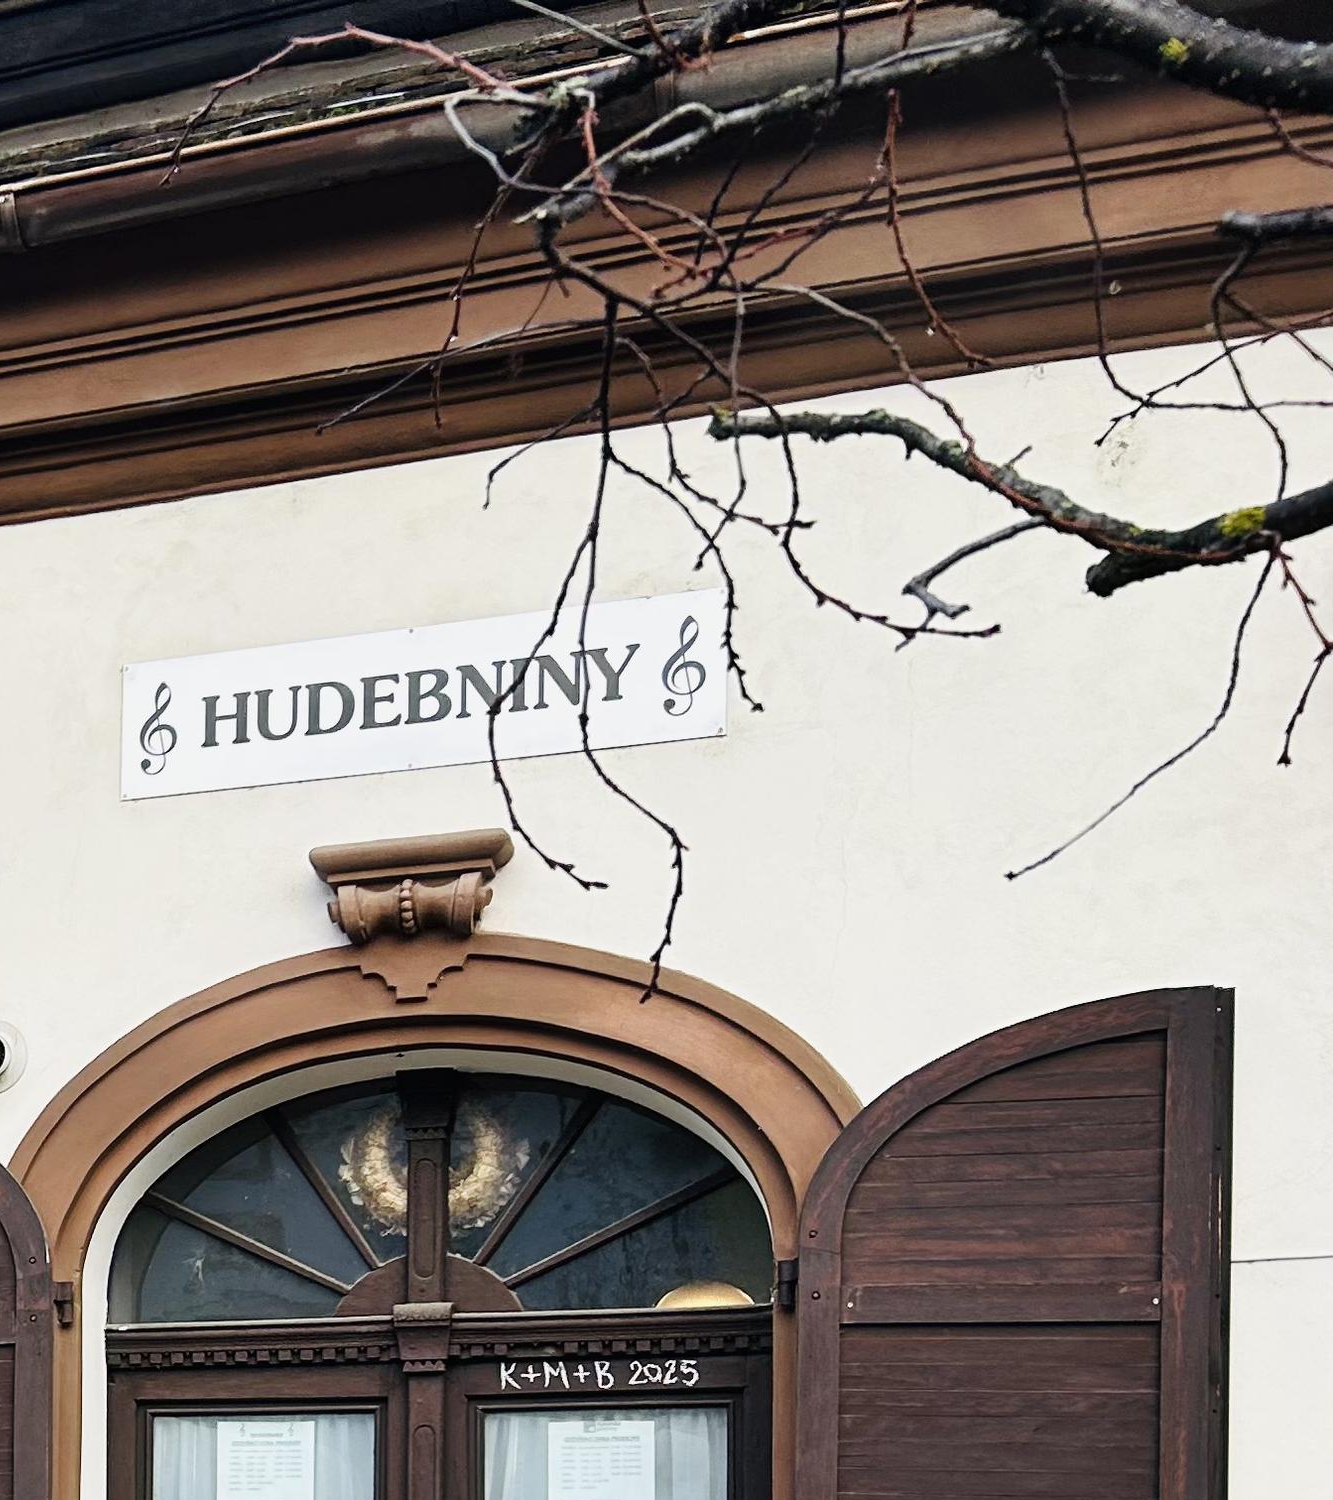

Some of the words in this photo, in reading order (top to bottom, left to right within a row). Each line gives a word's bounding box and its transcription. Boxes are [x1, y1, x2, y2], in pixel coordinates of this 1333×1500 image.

[200, 643, 640, 748] HUDEBNINY
[499, 1360, 615, 1390] K+M+B
[628, 1359, 700, 1387] 2025
